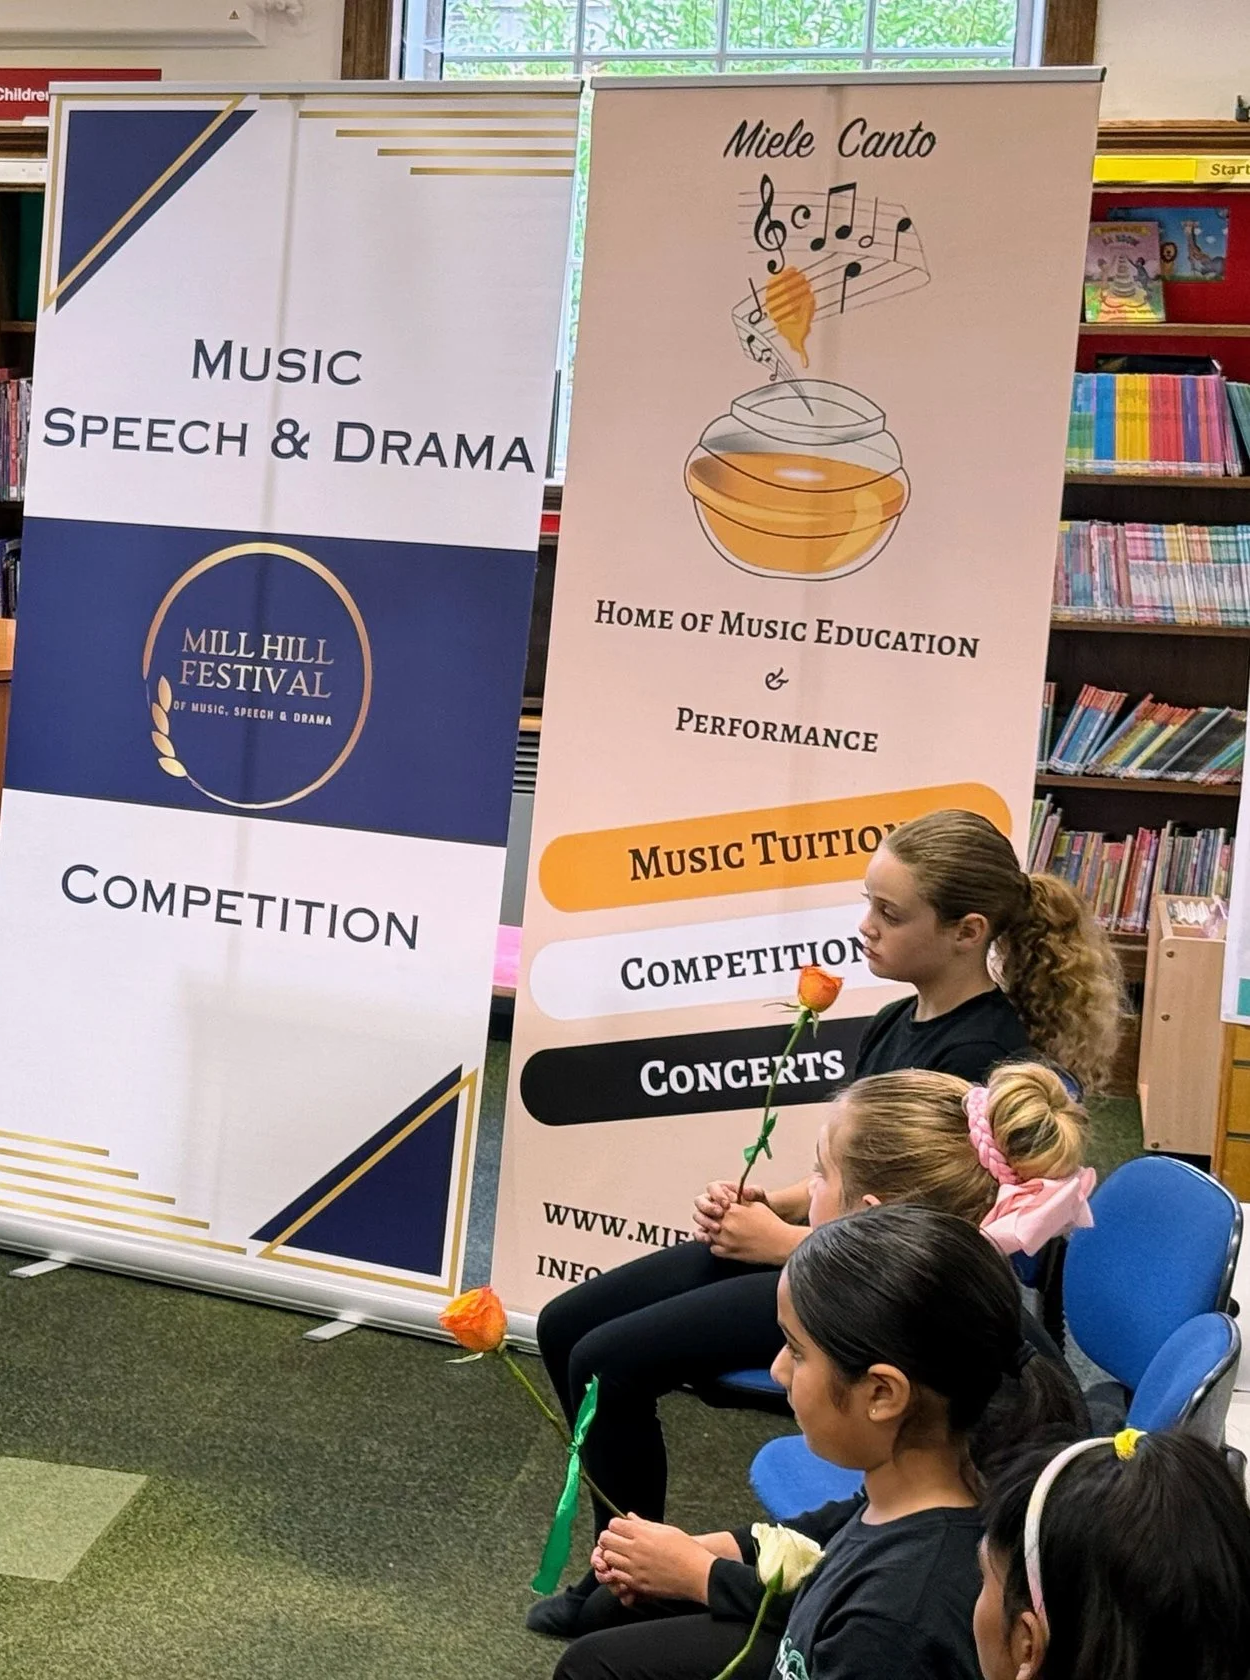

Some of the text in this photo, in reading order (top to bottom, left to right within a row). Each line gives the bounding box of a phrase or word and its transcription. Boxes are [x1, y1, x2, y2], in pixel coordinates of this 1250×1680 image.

[723, 117, 937, 159] Miele Canto
[269, 418, 311, 461] &
[181, 628, 335, 667] MILL HILL
[179, 659, 332, 699] FESTIVAL
[764, 667, 790, 692] &
[173, 701, 332, 726] OF MUSIC, SPEECH & DRAMA
[751, 821, 906, 866] TUITIO
